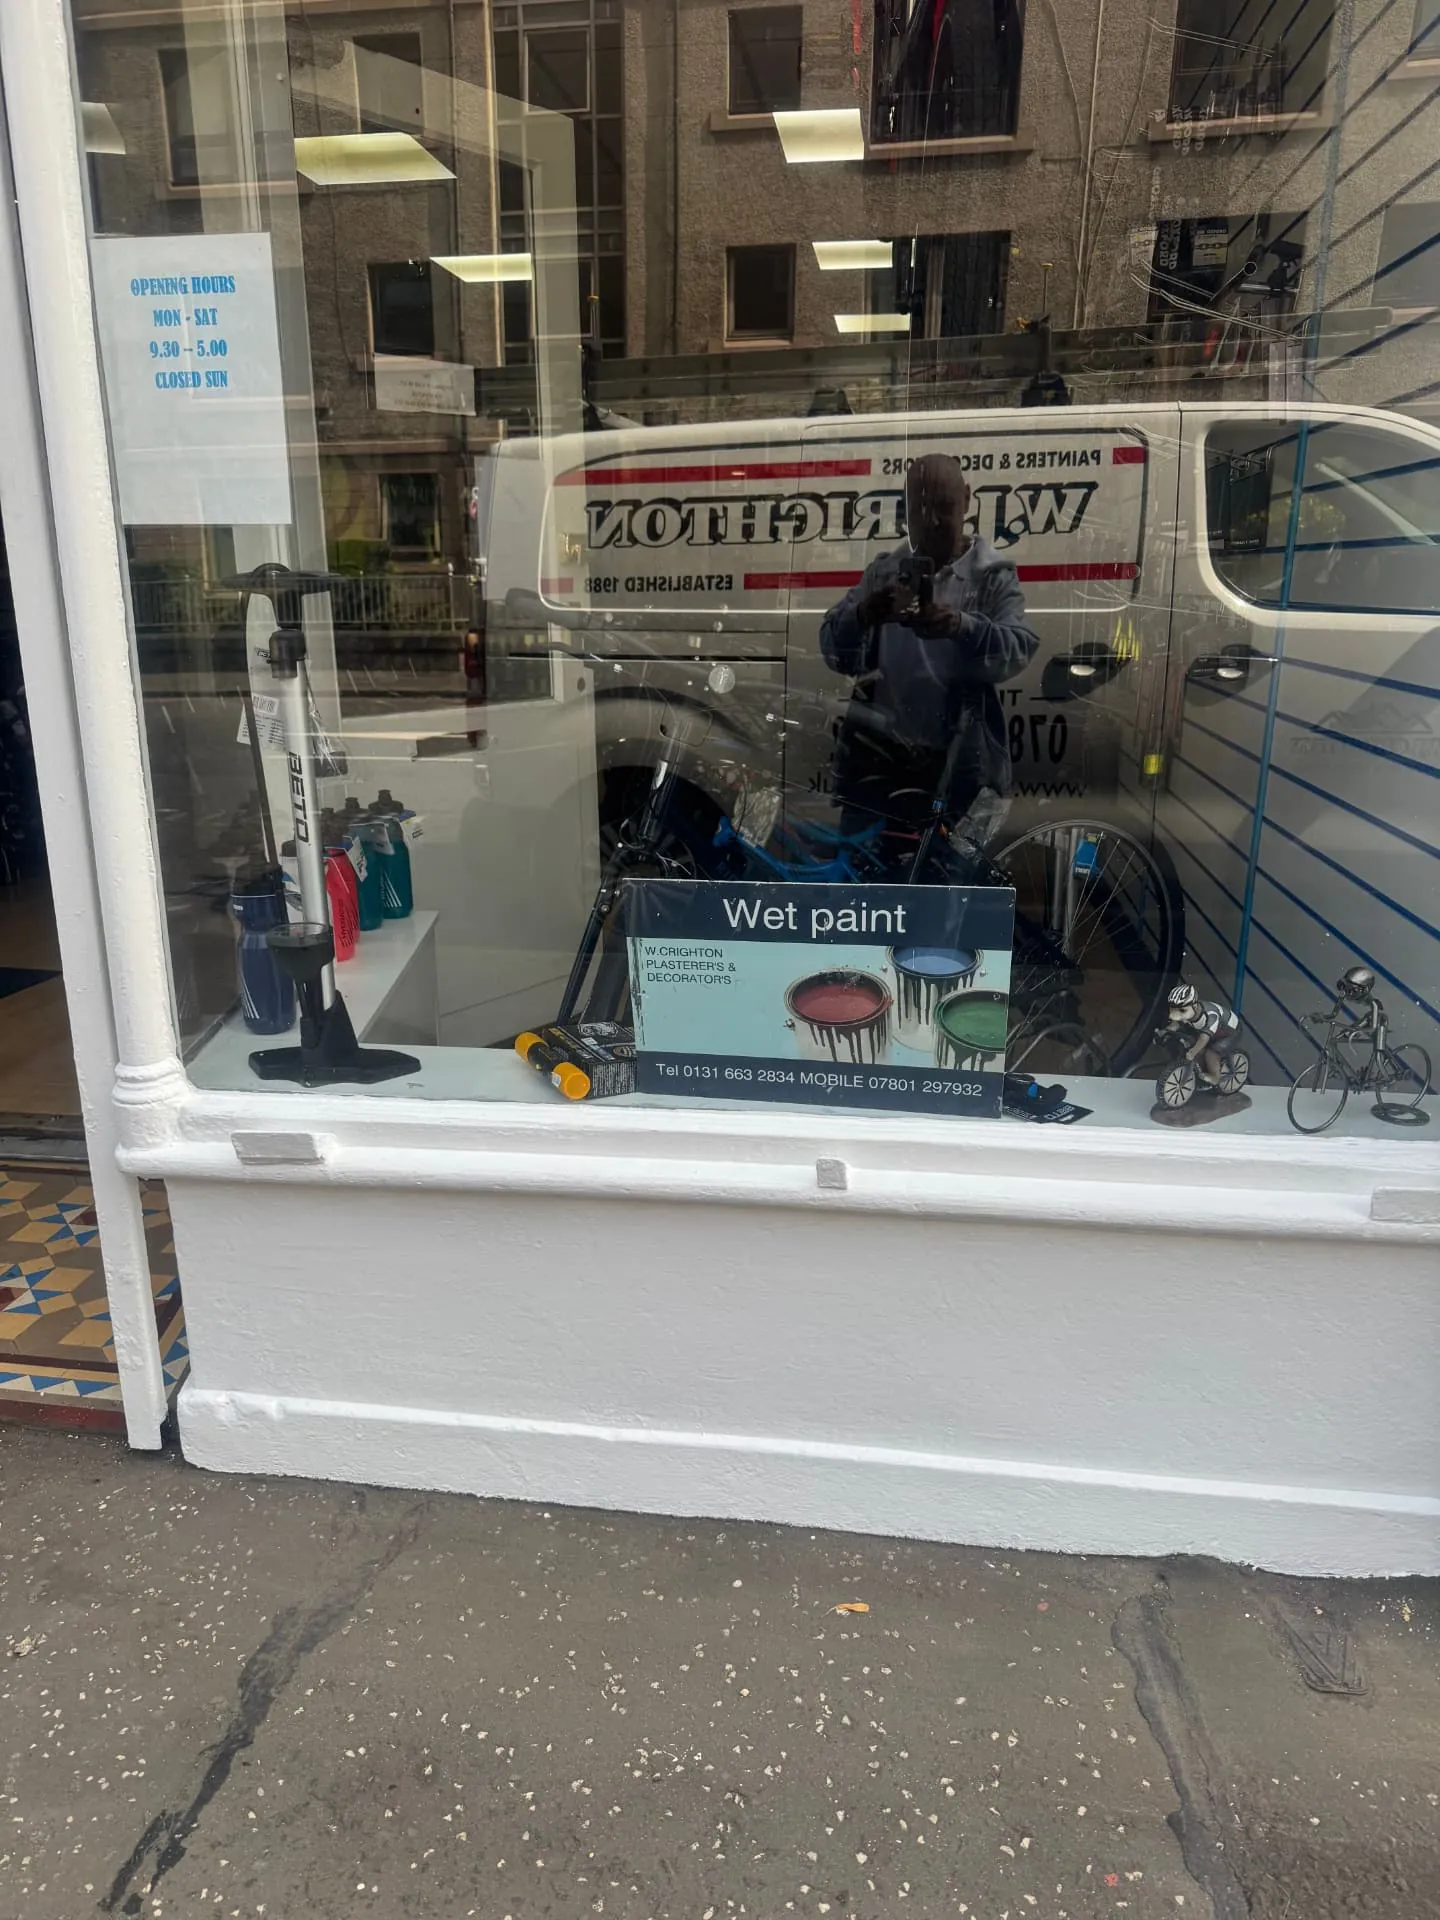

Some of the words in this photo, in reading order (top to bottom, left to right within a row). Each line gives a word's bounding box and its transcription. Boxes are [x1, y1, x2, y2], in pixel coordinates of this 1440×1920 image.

[130, 277, 188, 296] OPENING
[191, 275, 236, 294] HOURS
[153, 309, 181, 327] MON
[194, 308, 218, 326] SAT
[149, 341, 180, 358] 9.30
[197, 340, 227, 357] 5.00
[155, 371, 201, 389] CLOSED
[205, 370, 228, 388] SUN
[289, 752, 309, 843] BETO
[722, 899, 798, 930] Wet
[811, 902, 907, 939] paint
[644, 946, 723, 959] W.CRIGHTON
[646, 960, 725, 972] PLASTERER'S
[728, 963, 737, 972] &
[647, 973, 732, 985] DECORATOR'S
[656, 1063, 679, 1077] Tel
[683, 1065, 718, 1079] 0131
[724, 1067, 752, 1081] 663
[757, 1069, 795, 1083] 2834
[800, 1072, 864, 1088] MOBILE
[869, 1076, 915, 1092] 07801
[922, 1080, 983, 1097] 297932
